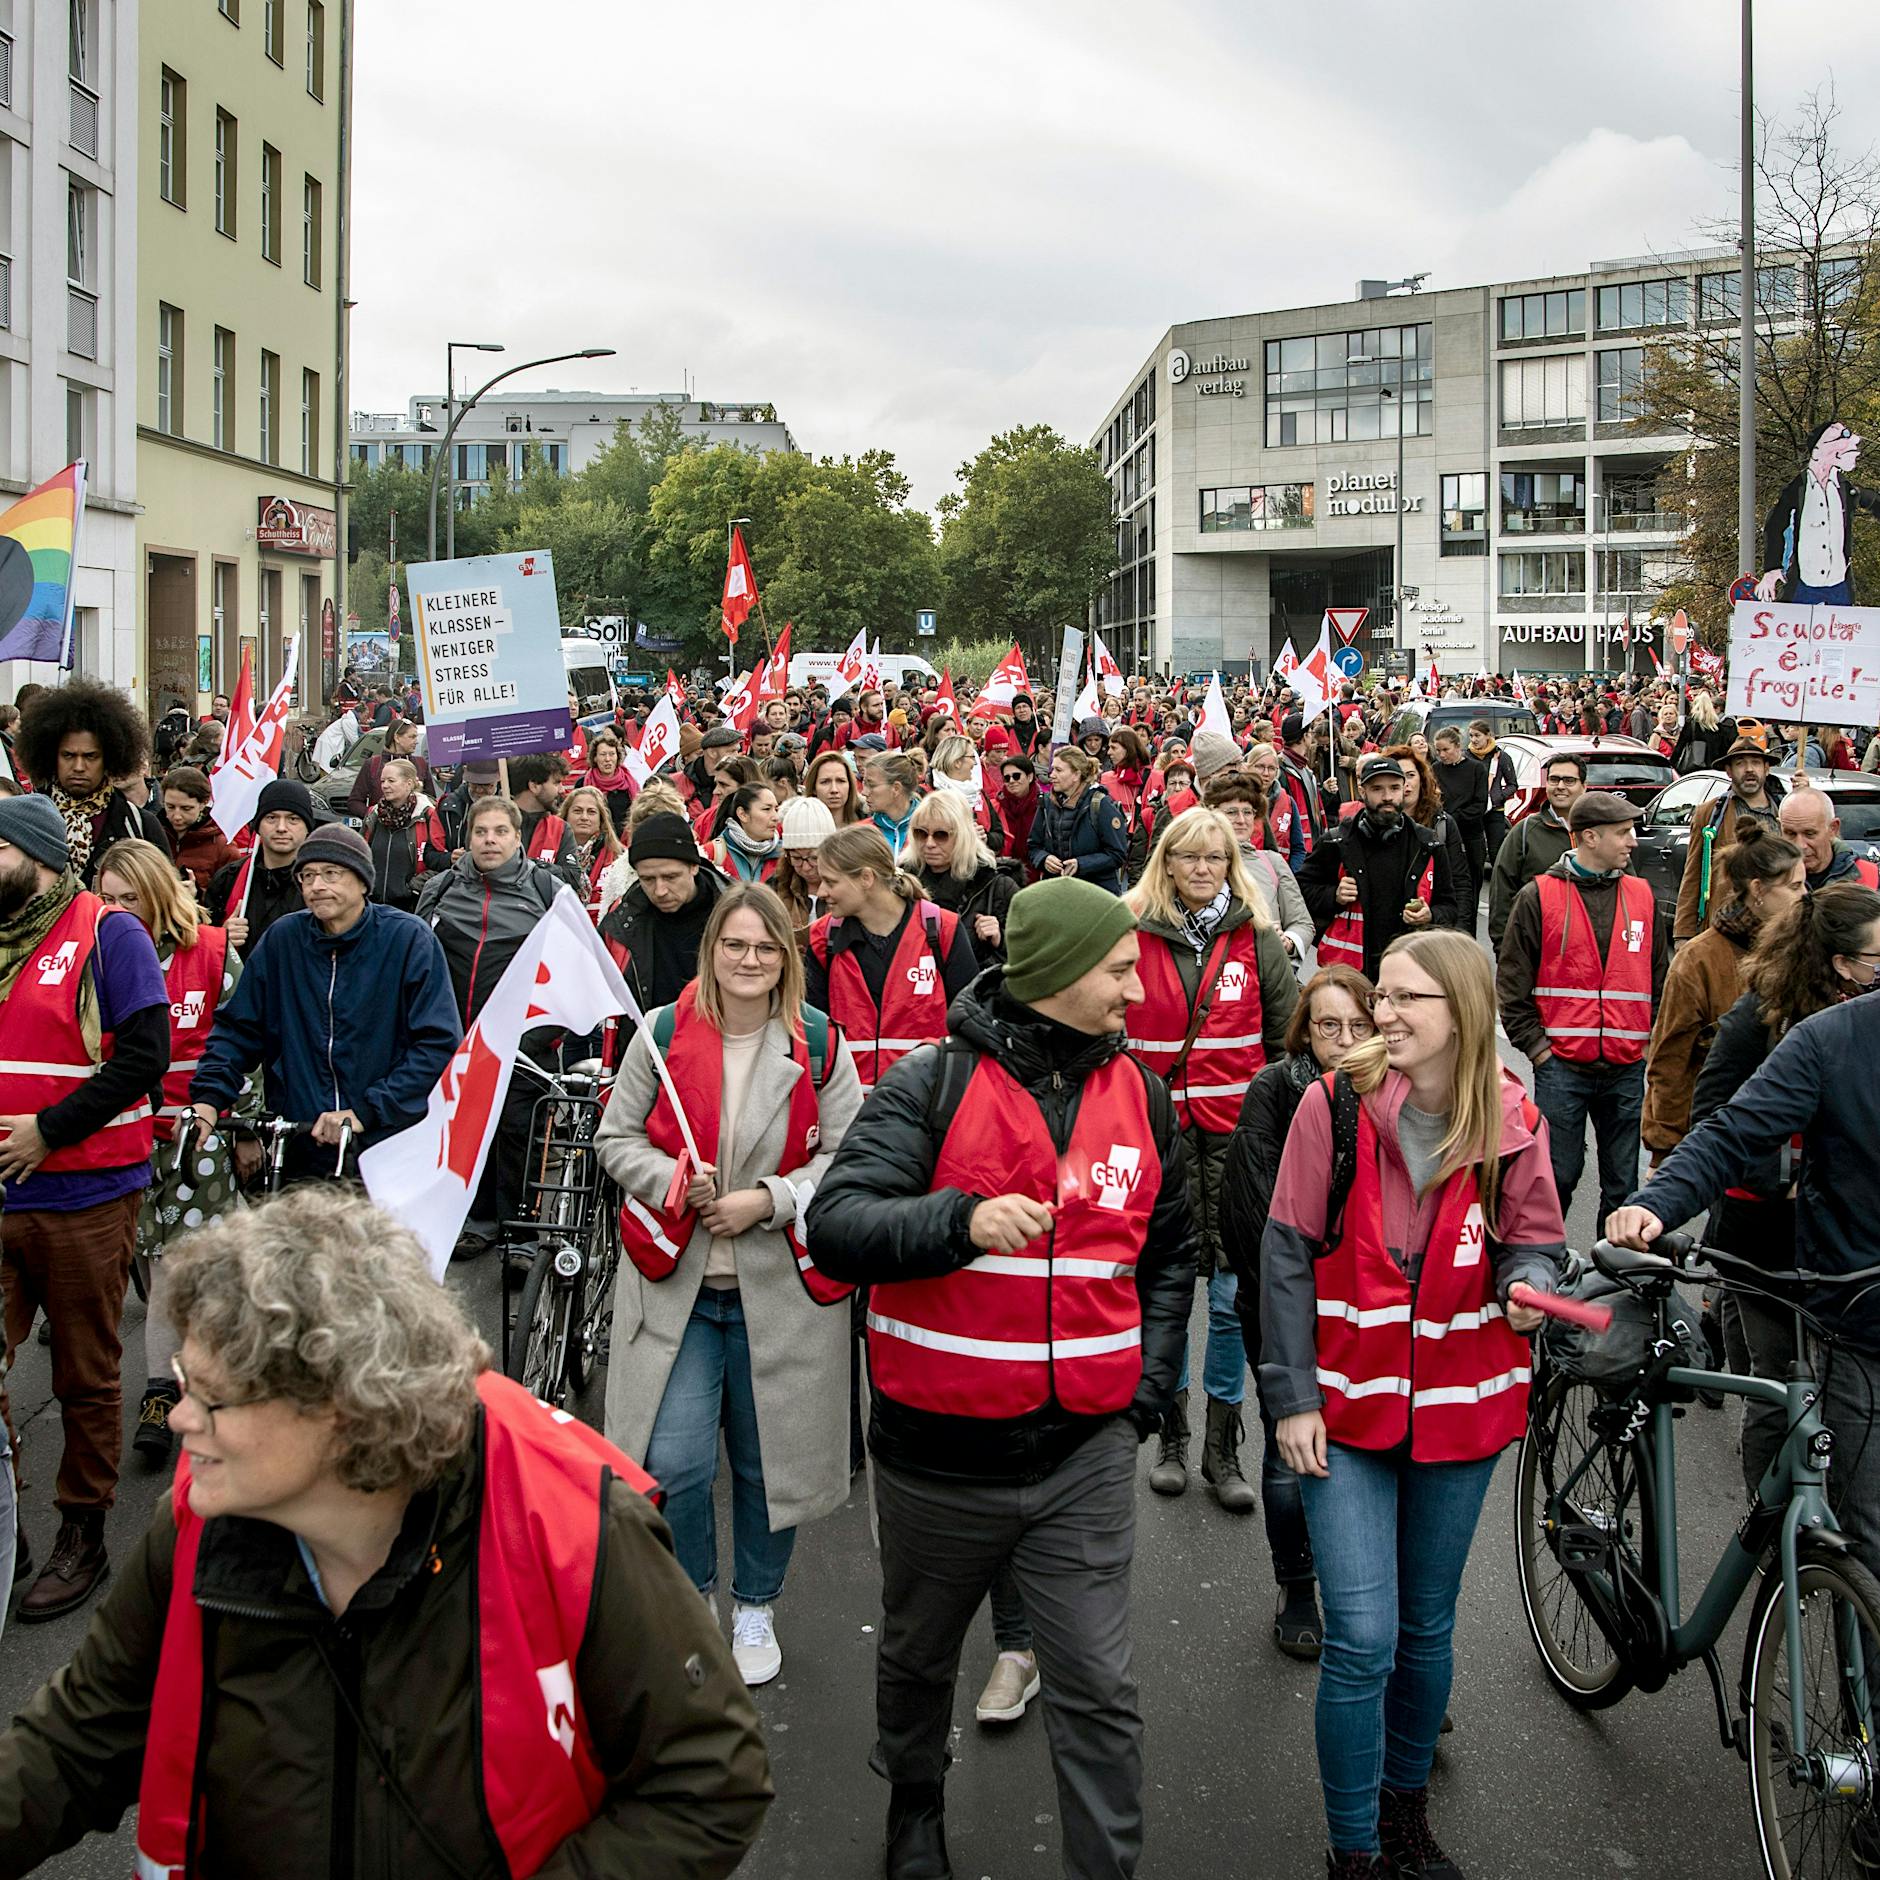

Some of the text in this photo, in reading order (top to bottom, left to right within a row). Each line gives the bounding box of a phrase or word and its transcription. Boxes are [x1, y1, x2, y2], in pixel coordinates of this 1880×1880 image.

[1193, 354, 1248, 374] aufbau
[1195, 375, 1243, 397] verlag
[1326, 470, 1397, 497] planet
[1326, 491, 1422, 515] modulor
[260, 530, 300, 538] Schultheiss
[427, 591, 497, 611] KLEINERE
[1419, 602, 1449, 613] design
[429, 616, 491, 635] KLASSEN
[921, 615, 932, 628] U
[1419, 614, 1462, 623] akademie
[1750, 611, 1857, 641] Scuola
[587, 619, 627, 641] Soil
[1419, 626, 1444, 635] berlin
[1503, 625, 1584, 643] AUFBAU
[431, 639, 494, 658] WENIGER
[435, 664, 489, 682] STRESS
[439, 684, 515, 706] FÜR ALLE!
[1744, 667, 1862, 708] fragile!
[37, 955, 76, 972] GEW
[907, 967, 937, 983] GEW
[170, 1002, 206, 1018] GEW
[1091, 1161, 1142, 1193] GEW
